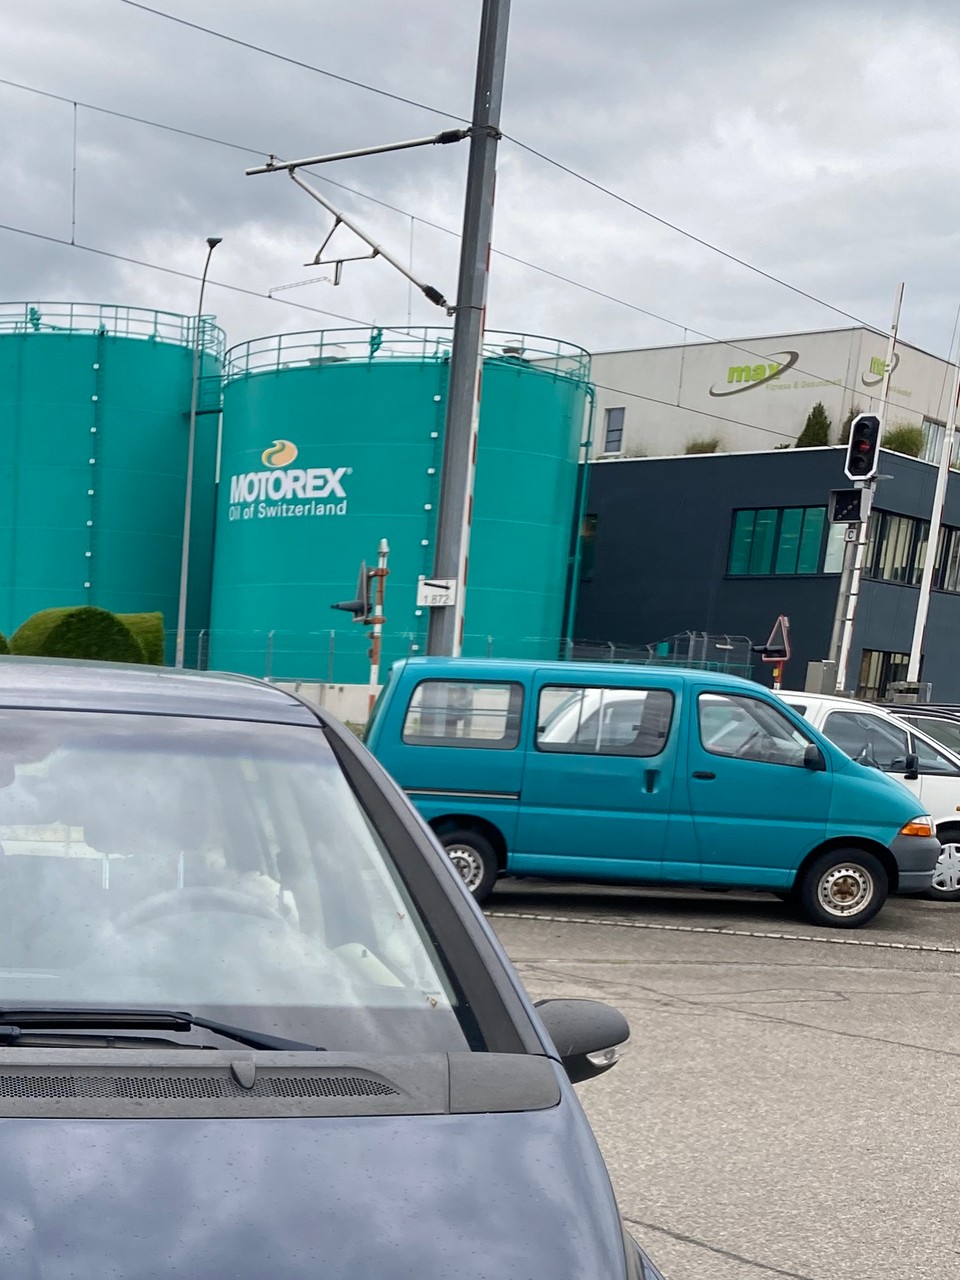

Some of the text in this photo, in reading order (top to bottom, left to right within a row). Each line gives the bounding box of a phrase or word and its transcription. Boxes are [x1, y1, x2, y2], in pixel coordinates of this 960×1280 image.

[229, 467, 348, 504] MOTOREX
[229, 500, 347, 520] Oil of Switzerland
